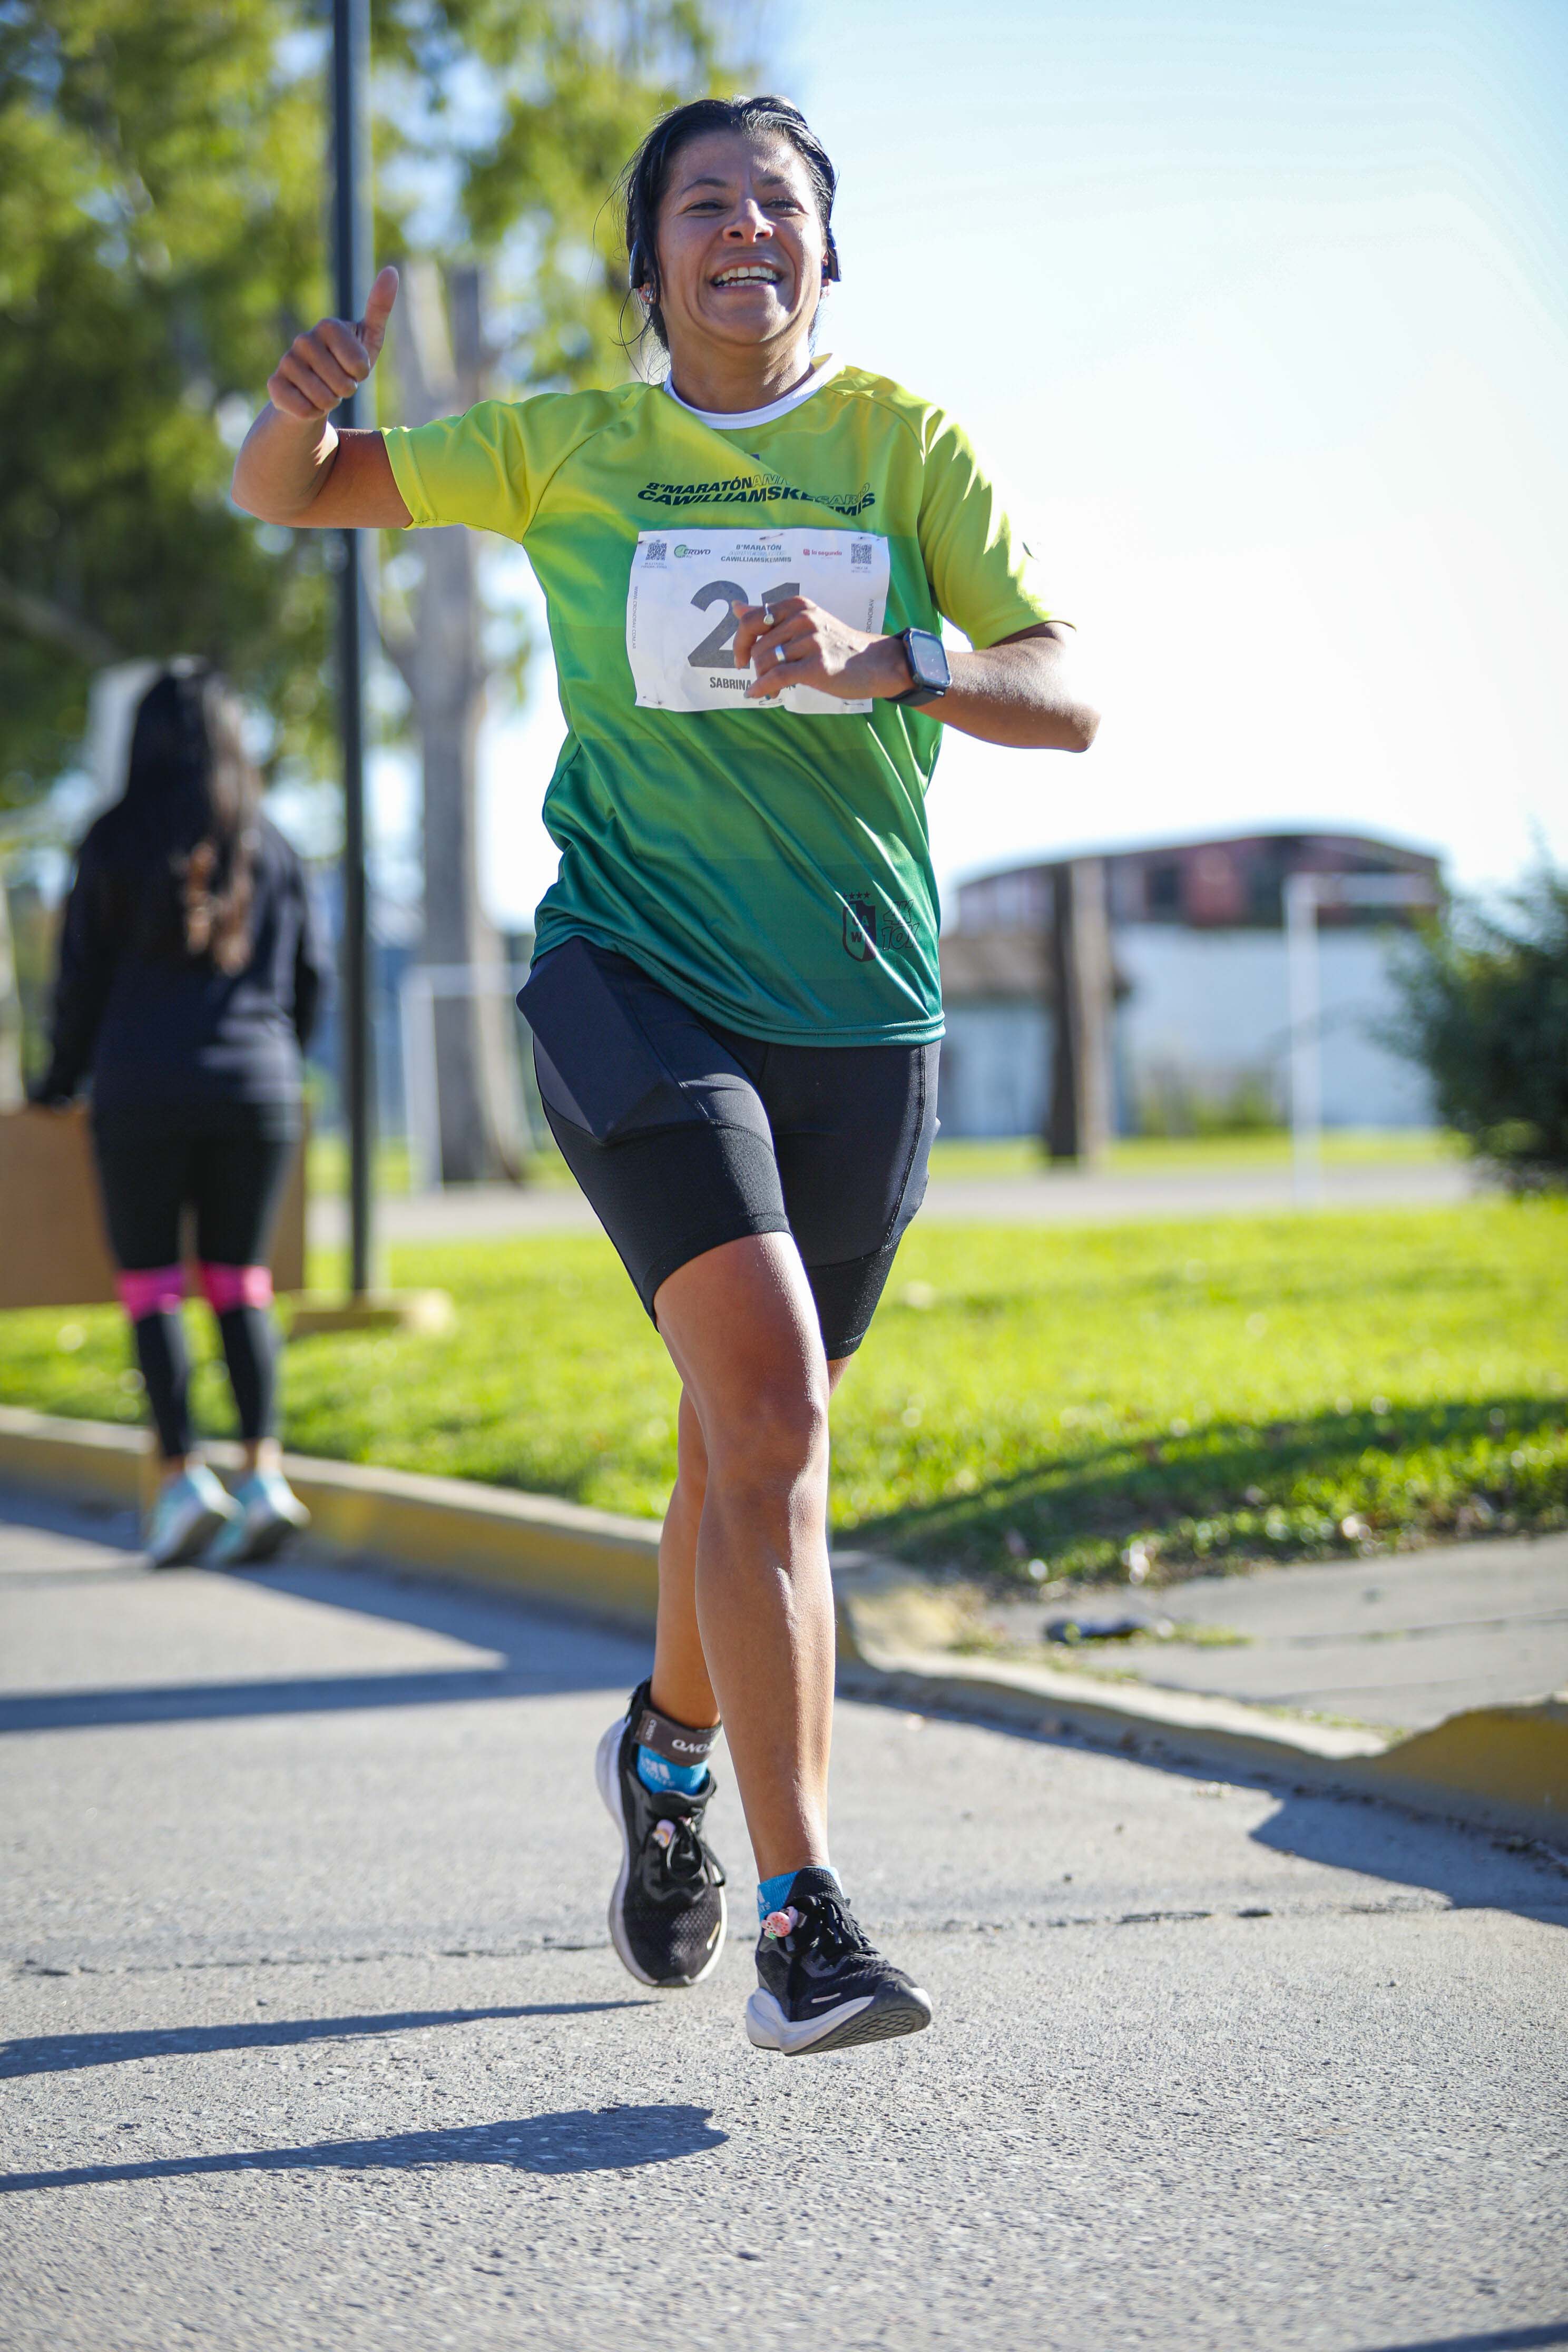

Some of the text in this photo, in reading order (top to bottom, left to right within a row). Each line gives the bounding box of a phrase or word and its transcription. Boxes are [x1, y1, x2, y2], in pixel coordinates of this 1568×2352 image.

[646, 476, 752, 494] 8°MARATÓN
[638, 485, 875, 516] CAWILLIAMSKMIS
[687, 580, 800, 669] 2
[709, 677, 751, 691] SABRINA
[851, 932, 862, 942] W
